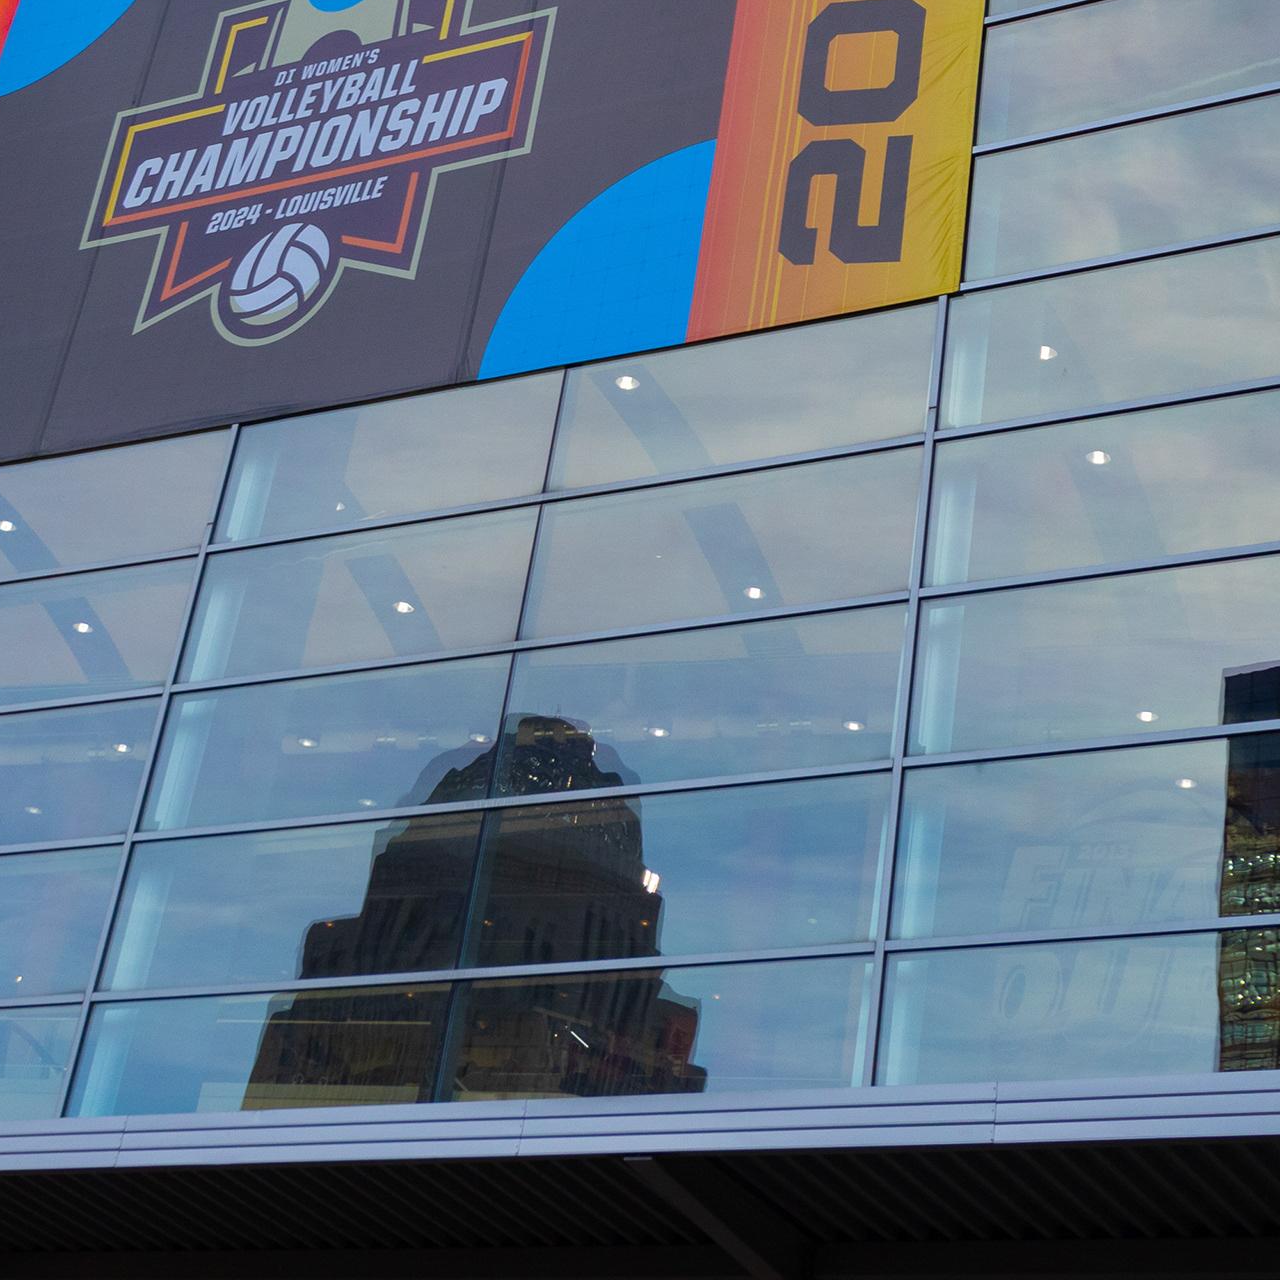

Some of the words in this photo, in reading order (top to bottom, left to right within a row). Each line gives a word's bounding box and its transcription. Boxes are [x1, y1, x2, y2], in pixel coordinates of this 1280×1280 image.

[222, 59, 419, 137] VOLLEYBALL
[274, 68, 297, 87] DI
[301, 48, 381, 81] WOMEN'S
[123, 77, 509, 209] CHAMPIONSHIP
[205, 203, 263, 235] 2024
[274, 176, 388, 220] LOUISVILLE
